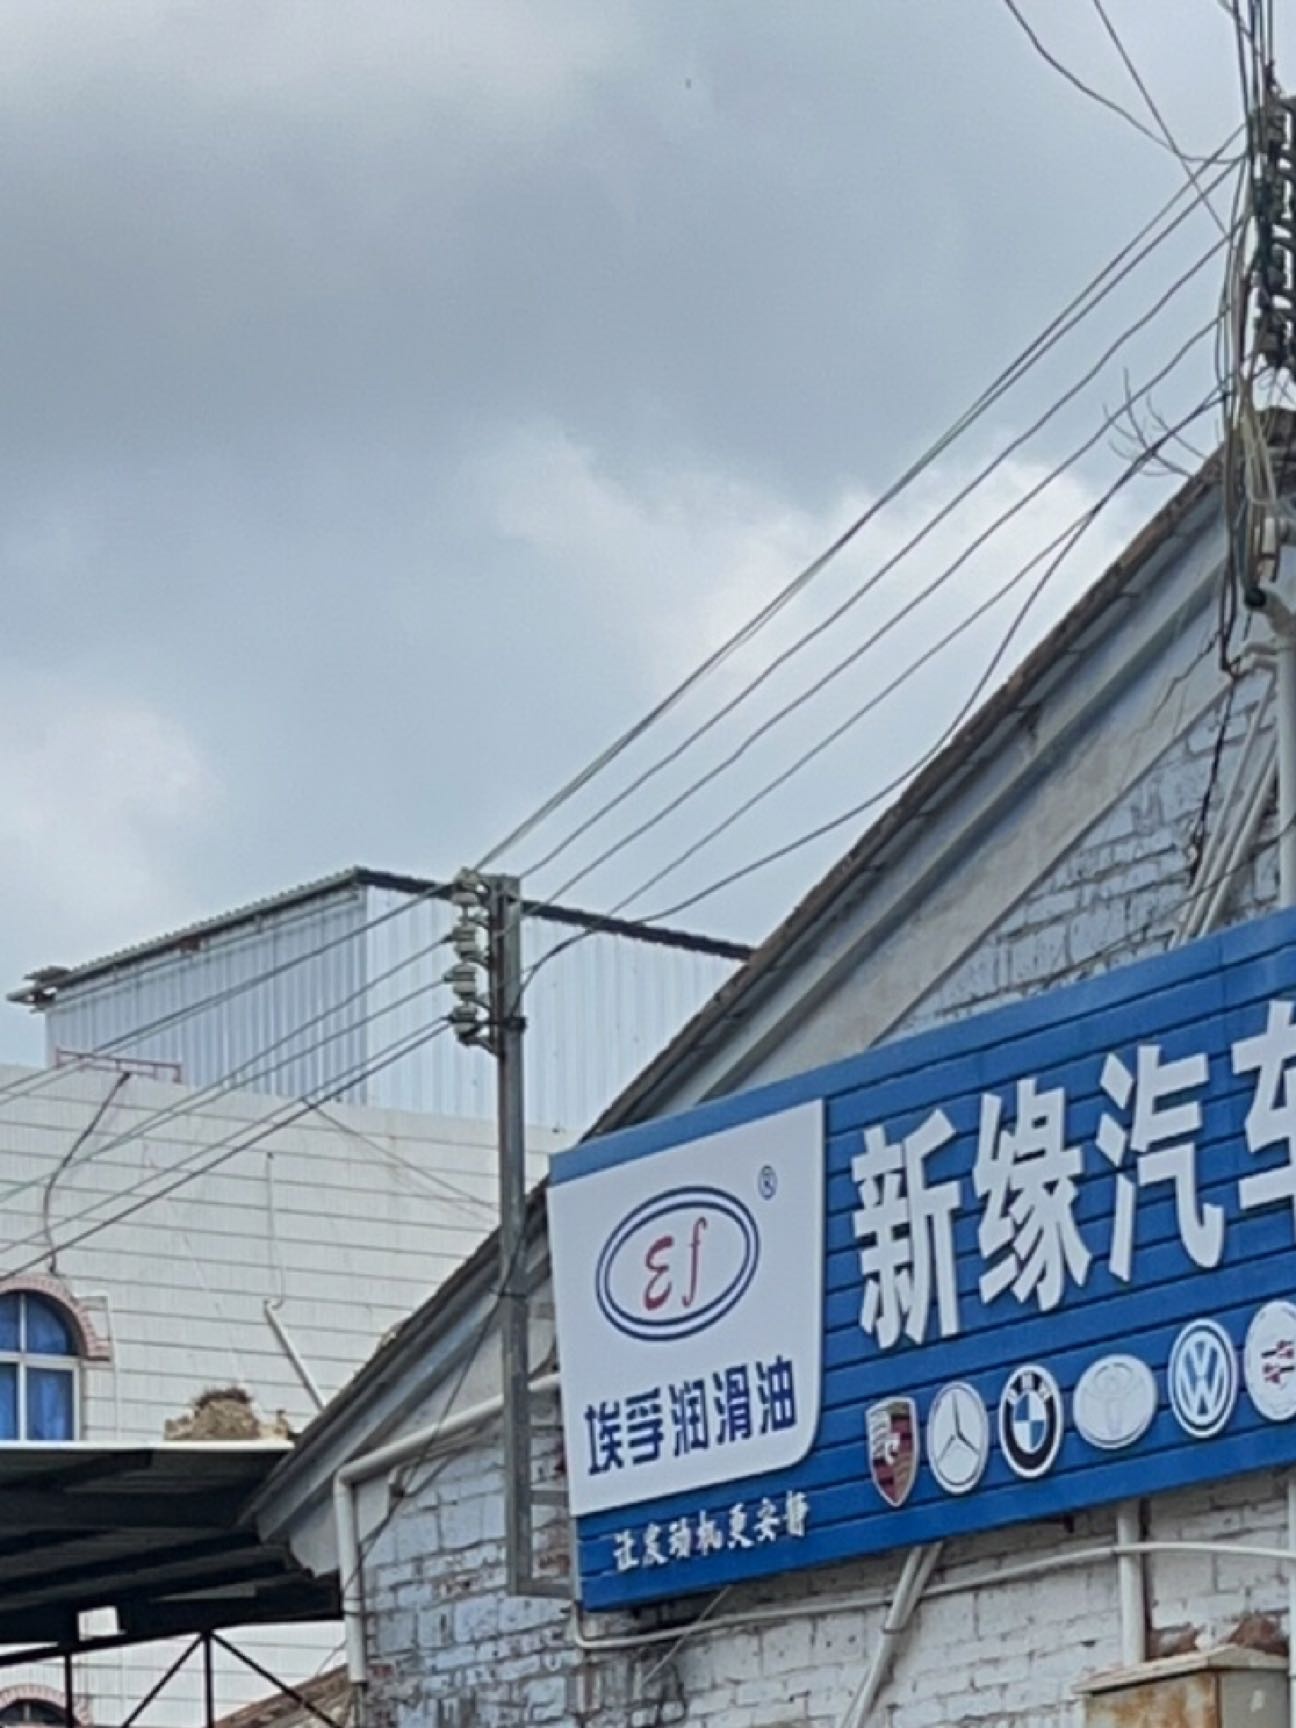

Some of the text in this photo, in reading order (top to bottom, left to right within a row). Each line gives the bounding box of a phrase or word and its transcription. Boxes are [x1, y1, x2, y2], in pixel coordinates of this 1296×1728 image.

[584, 1354, 798, 1476] 埃孚润滑油
